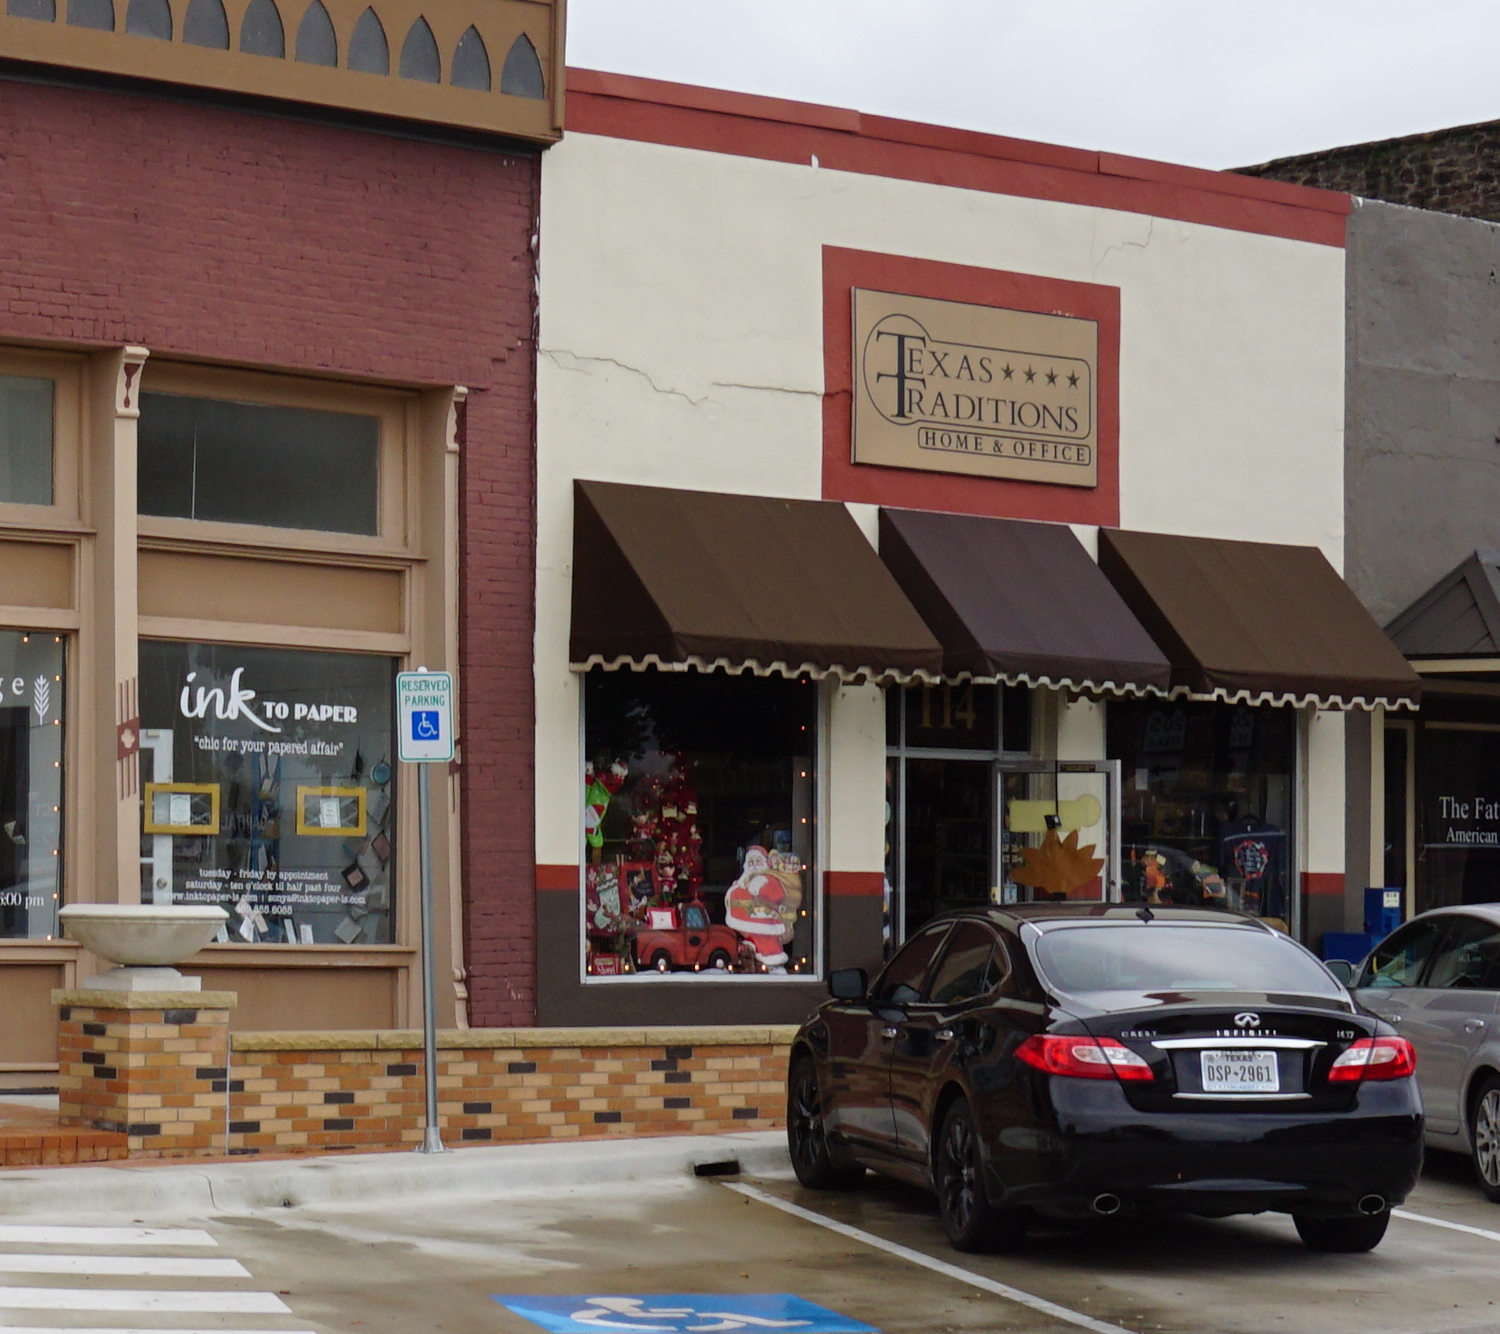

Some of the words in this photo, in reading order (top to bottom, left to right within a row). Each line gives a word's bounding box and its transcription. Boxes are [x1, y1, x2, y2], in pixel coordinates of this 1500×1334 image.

[876, 331, 993, 384] TEXAS
[876, 372, 1078, 433] TRADITIONS
[925, 431, 983, 451] HOME
[993, 440, 1003, 454] &
[1013, 441, 1086, 463] OFFICE
[402, 679, 449, 692] RESERVED
[180, 667, 282, 733] ink
[263, 701, 290, 719] TO
[294, 703, 357, 723] PAPER
[405, 695, 446, 707] PARKING
[223, 736, 238, 752] for
[241, 741, 265, 755] your
[268, 741, 308, 757] papered
[1439, 796, 1469, 819] The
[1446, 826, 1498, 844] American
[25, 895, 44, 910] pm
[1216, 1029, 1276, 1037] INFINITI
[1224, 1054, 1253, 1063] TEXAS
